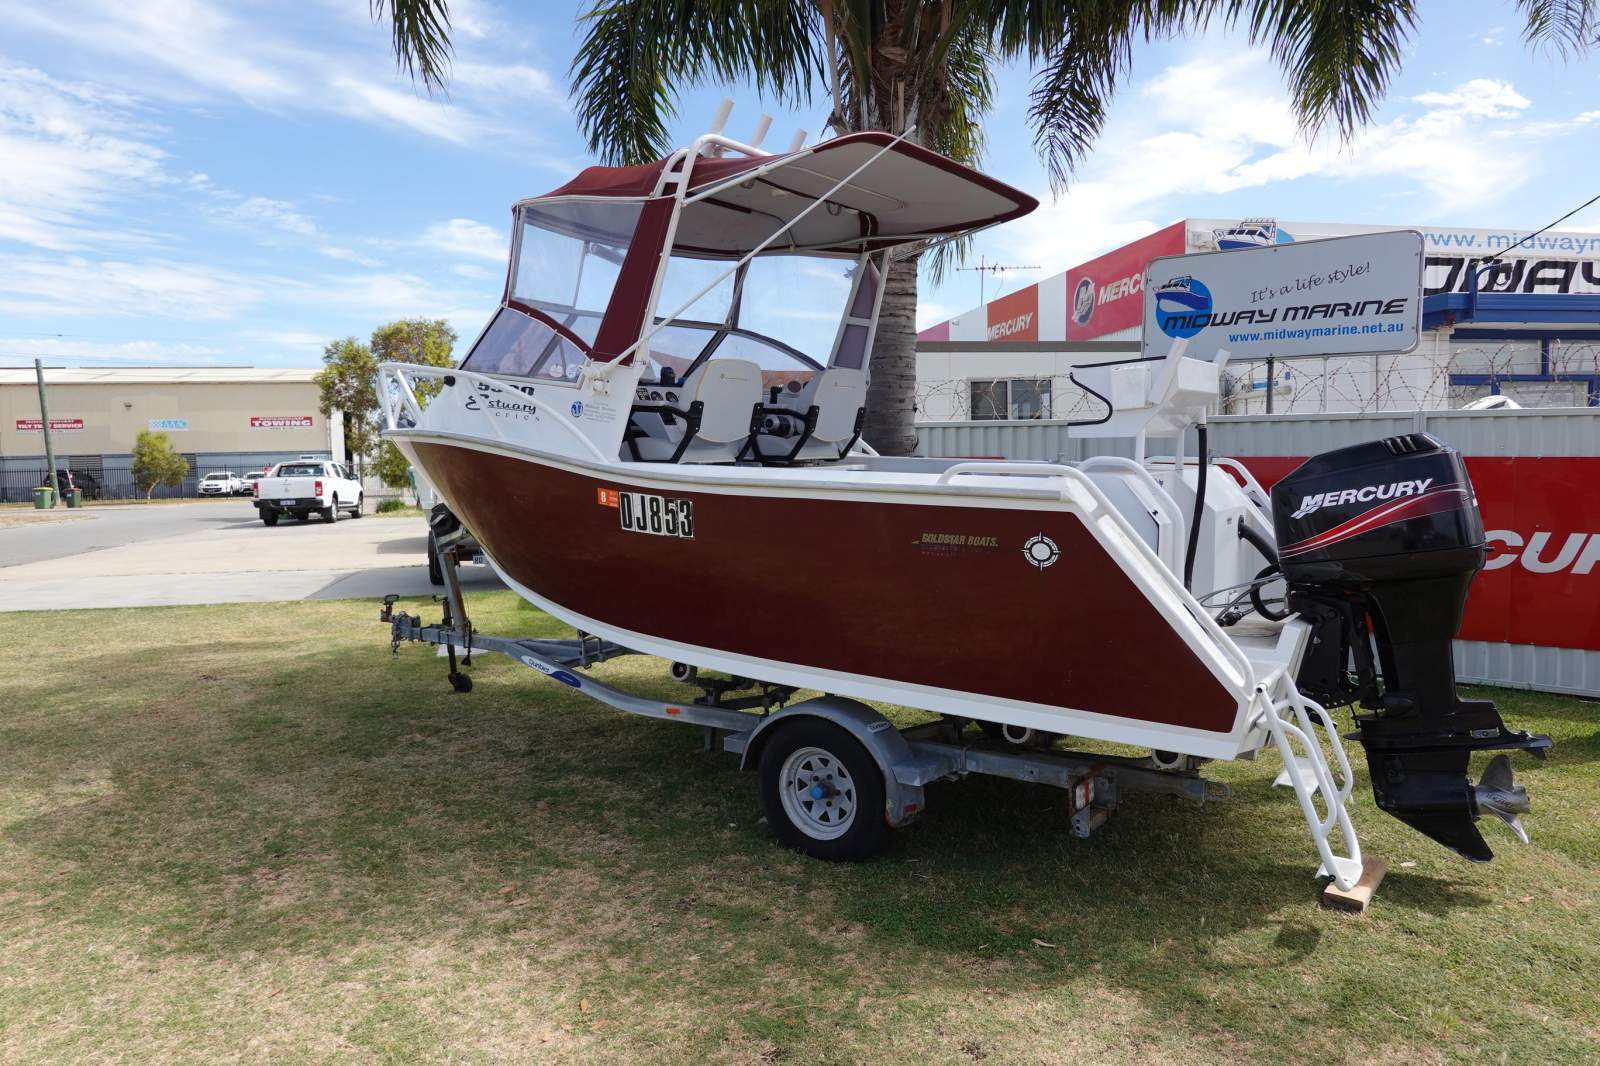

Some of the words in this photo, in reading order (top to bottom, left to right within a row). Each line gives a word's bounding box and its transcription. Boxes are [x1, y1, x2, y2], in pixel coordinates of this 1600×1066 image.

[1424, 232, 1600, 254] ww.midway
[1250, 287, 1275, 304] It's
[1279, 284, 1294, 296] a
[1296, 274, 1325, 291] life
[1328, 262, 1371, 283] style!
[985, 311, 1034, 341] MERCURY
[1163, 308, 1278, 331] MIDWAY
[1282, 298, 1409, 321] MARINE
[1229, 322, 1404, 342] www.midwaymarine.net.au
[1291, 478, 1433, 517] MERCURY
[620, 493, 693, 537] DJ853
[922, 533, 966, 545] GOLDSTAR
